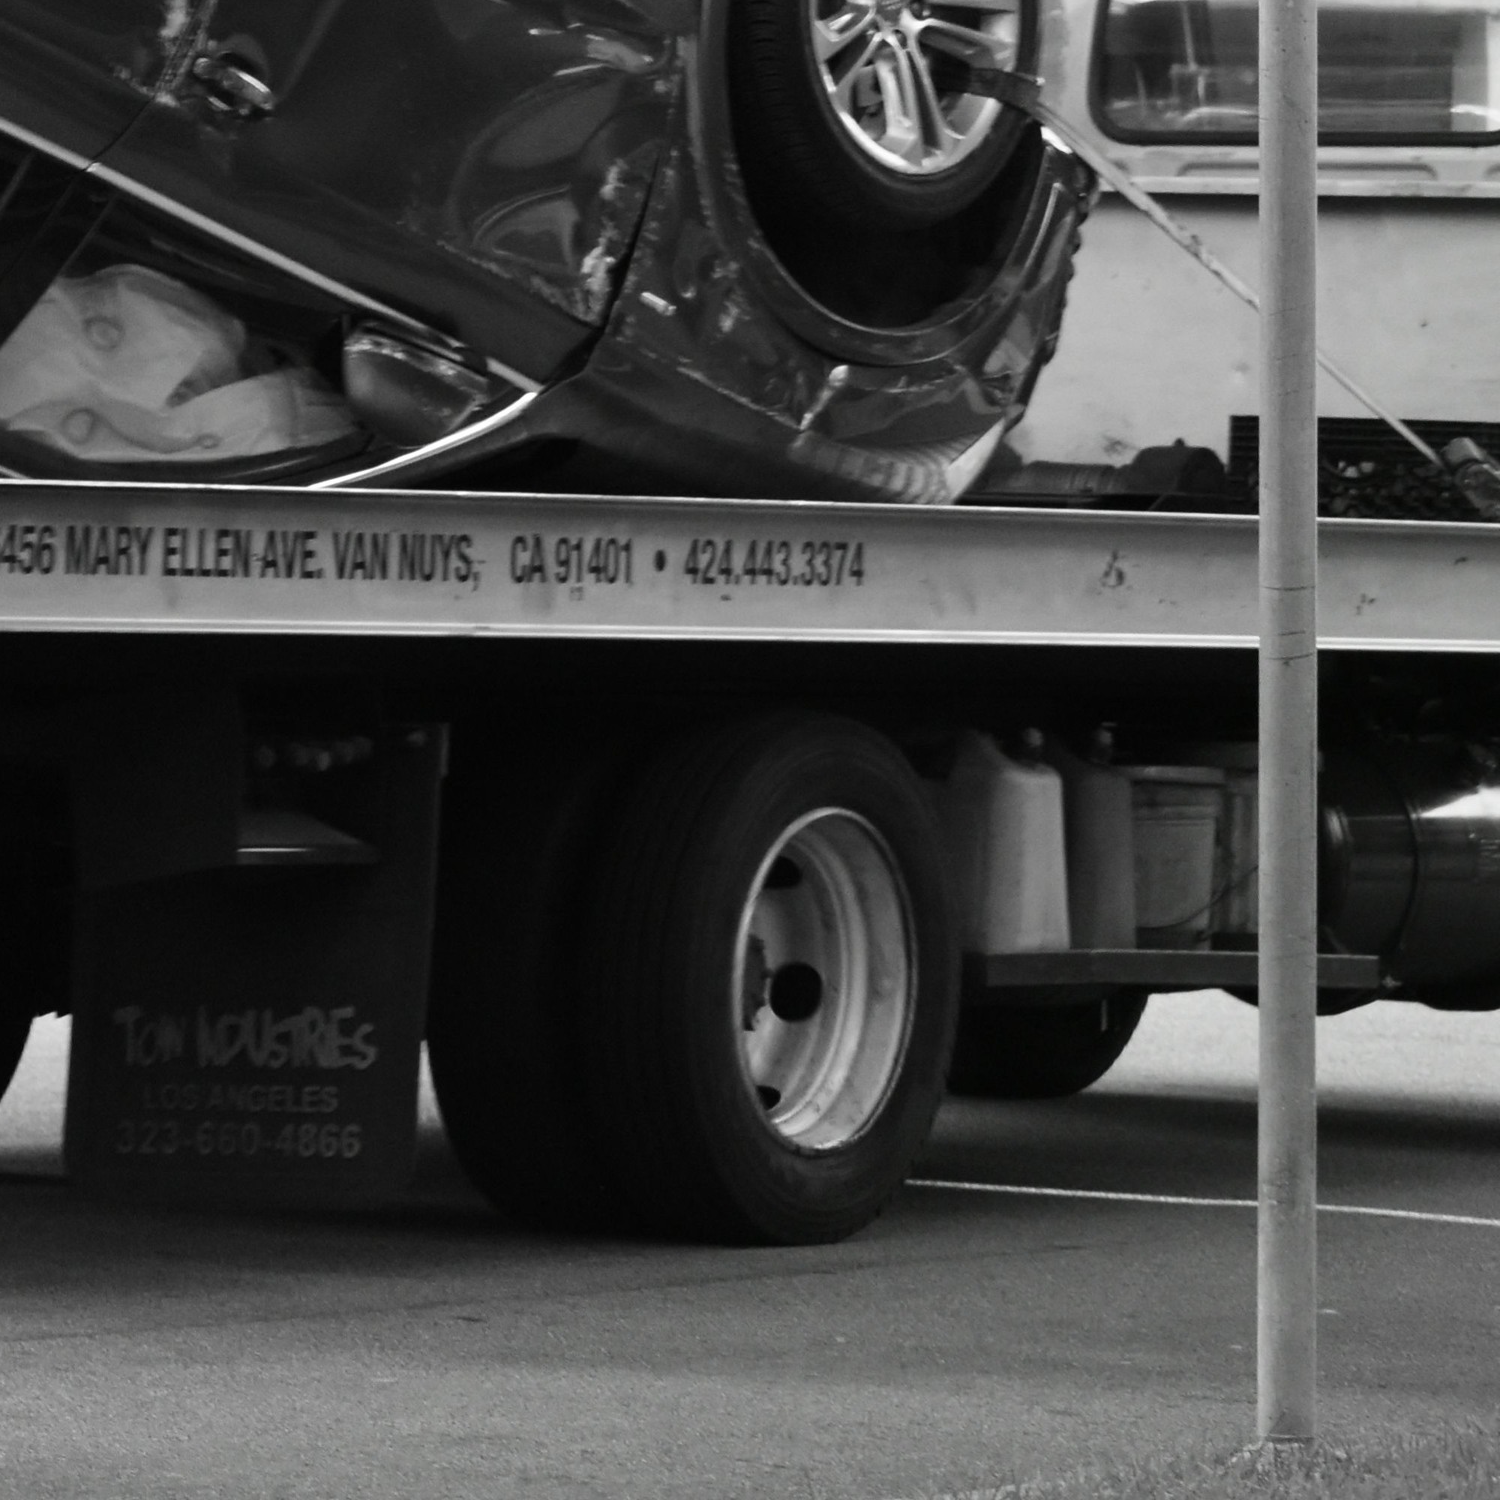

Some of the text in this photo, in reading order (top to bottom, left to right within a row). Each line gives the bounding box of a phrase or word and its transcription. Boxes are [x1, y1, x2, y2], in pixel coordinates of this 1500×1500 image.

[65, 525, 155, 576] MARY
[162, 527, 251, 579] ELLEN
[333, 531, 389, 580] VAN
[510, 534, 548, 583] CA
[555, 536, 633, 584] 91401
[685, 539, 865, 586] 424.443.3374
